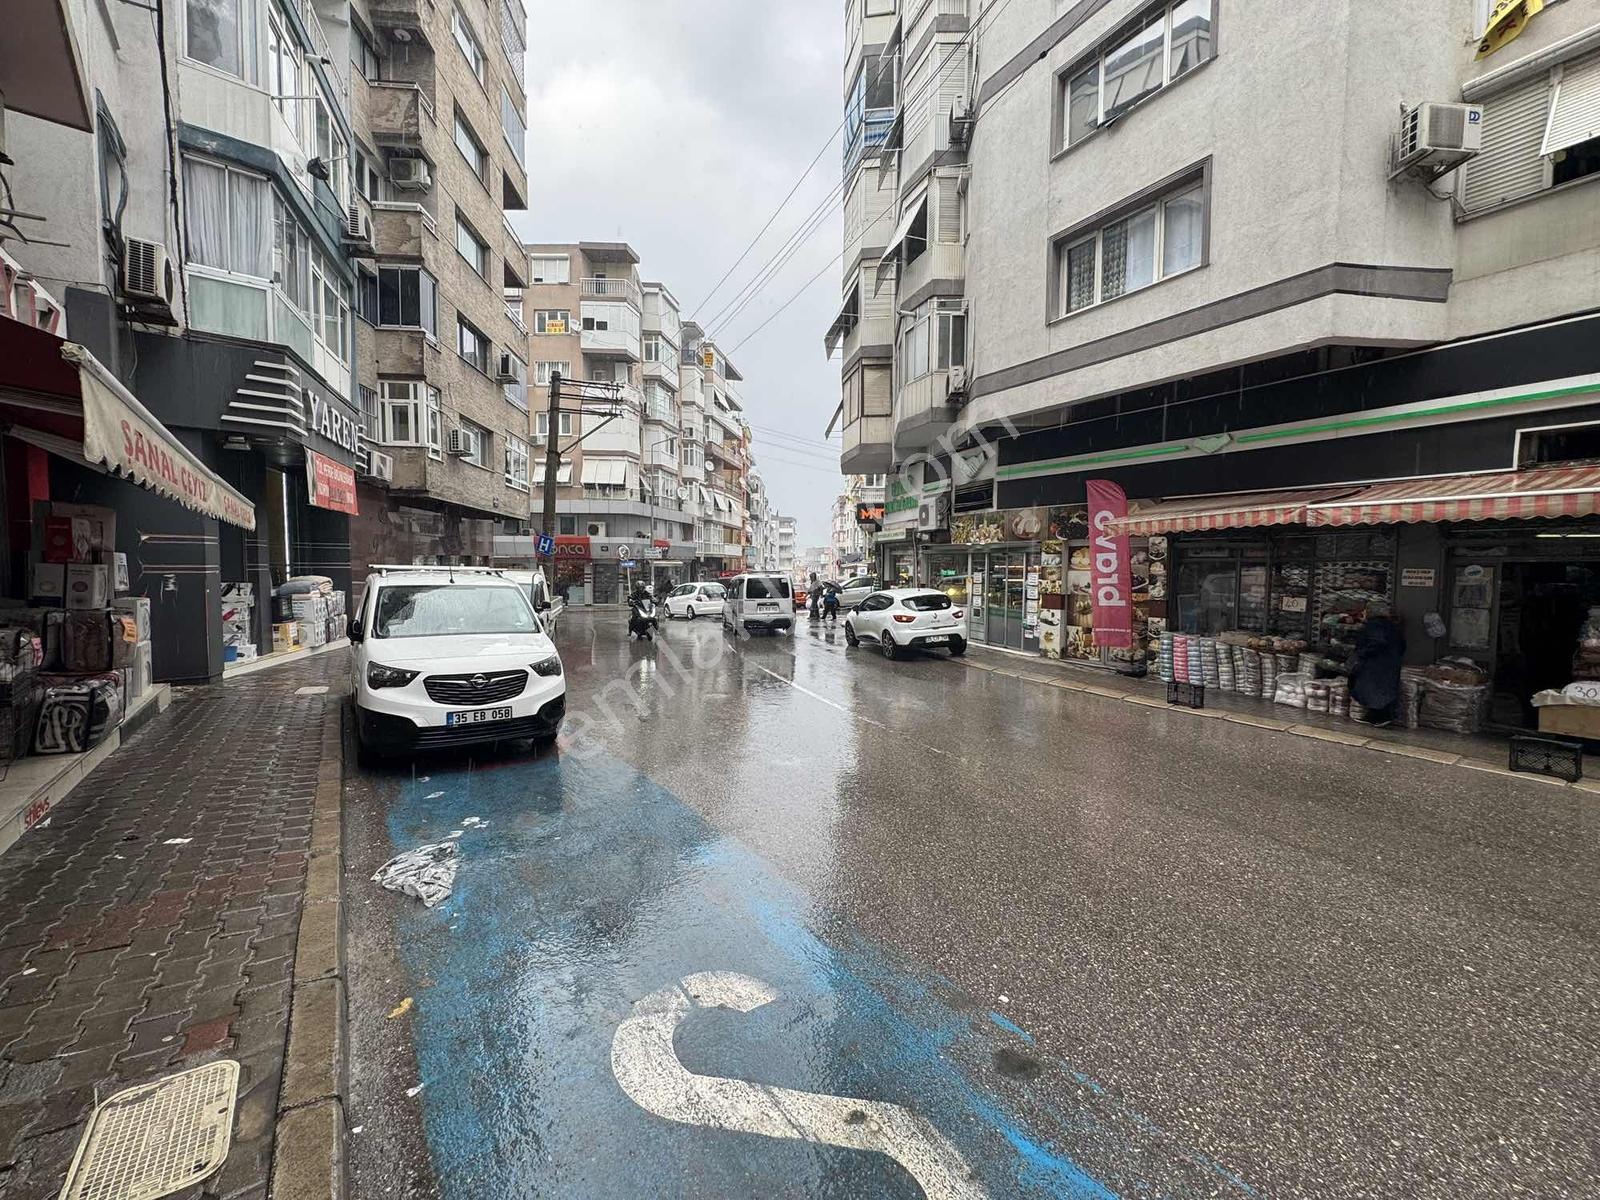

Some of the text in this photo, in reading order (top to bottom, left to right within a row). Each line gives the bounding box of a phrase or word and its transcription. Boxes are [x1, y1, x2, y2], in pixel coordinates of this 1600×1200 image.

[308, 389, 360, 456] YAREN
[539, 539, 550, 552] H
[454, 713, 468, 724] 35
[473, 711, 486, 722] EB
